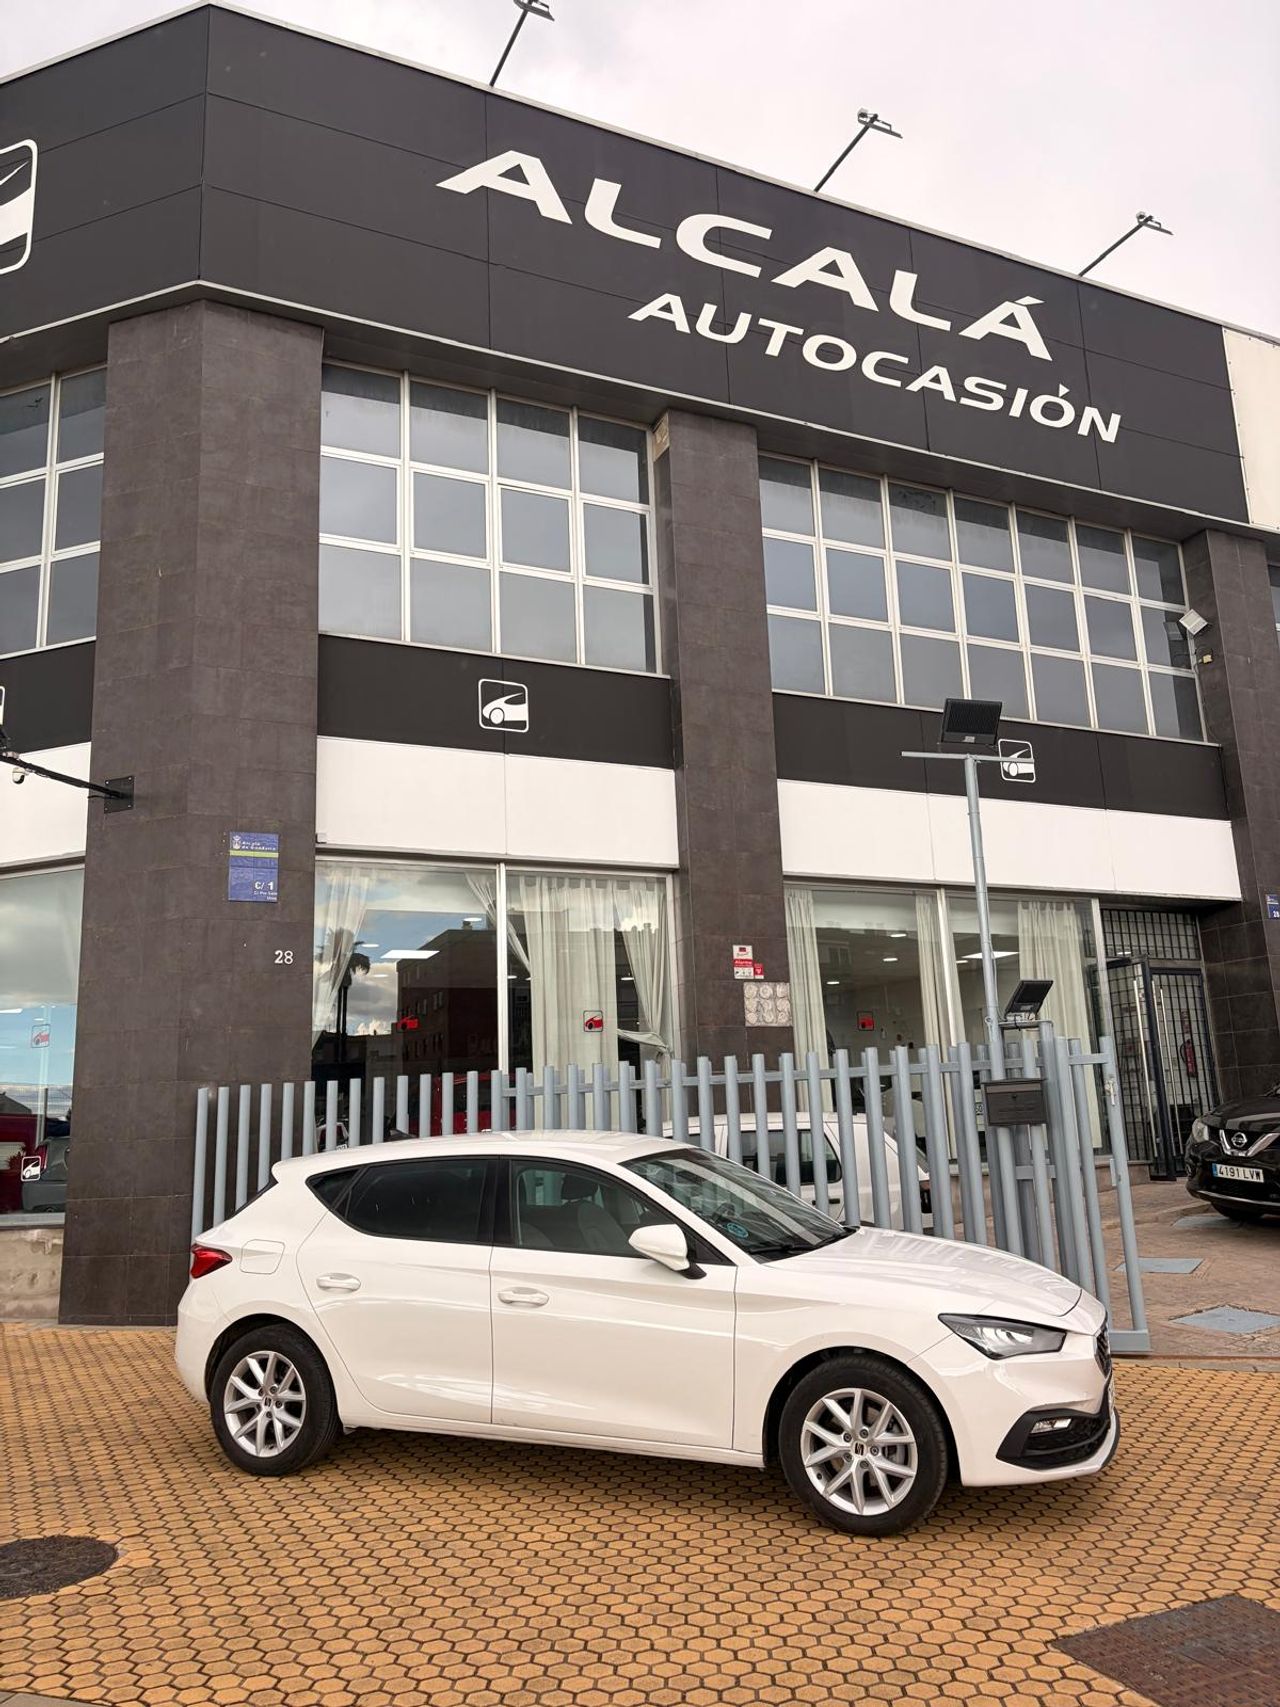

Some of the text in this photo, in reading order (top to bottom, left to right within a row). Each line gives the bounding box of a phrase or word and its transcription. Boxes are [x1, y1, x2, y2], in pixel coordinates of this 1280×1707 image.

[437, 151, 1052, 361] ALCALÁ
[629, 294, 1121, 443] AUTOCASIÓN
[267, 881, 274, 891] 1
[274, 949, 294, 964] 28
[1219, 1166, 1261, 1180] 4191 LVW
